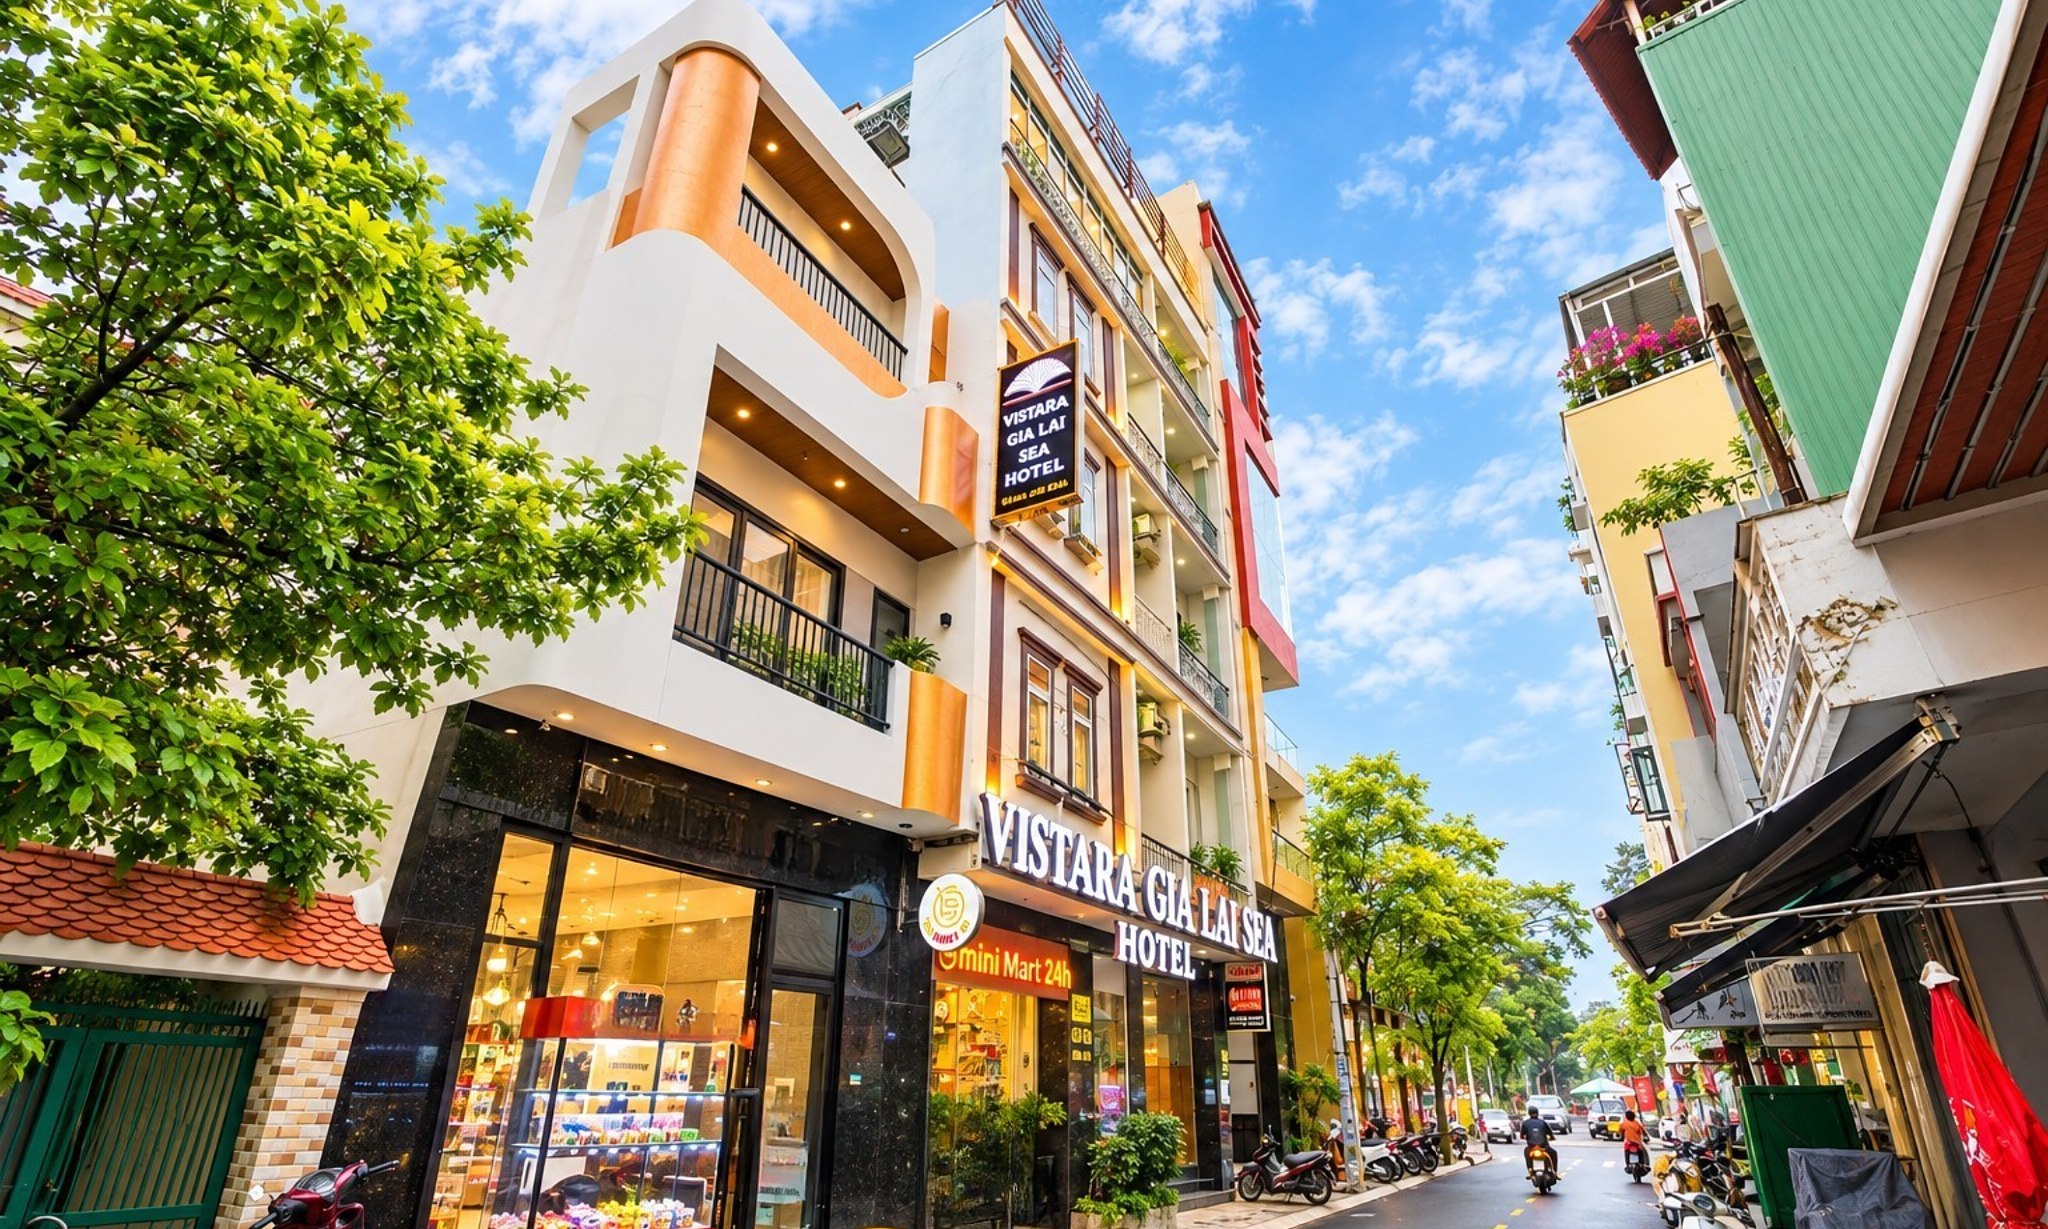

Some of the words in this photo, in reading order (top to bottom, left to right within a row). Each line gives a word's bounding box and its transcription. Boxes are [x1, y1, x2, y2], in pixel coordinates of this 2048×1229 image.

[1003, 395, 1069, 427] VISTARA
[1006, 429, 1036, 446] GIA
[1038, 415, 1067, 436] LAI
[1018, 443, 1050, 463] SEA
[1004, 458, 1065, 487] HOTEL
[980, 793, 1139, 916] VISTARA
[1143, 866, 1196, 934] GIA
[1199, 888, 1239, 948] LAI
[1240, 906, 1278, 963] SEA
[958, 943, 1000, 976] mini
[1003, 951, 1042, 983] Mart
[1114, 920, 1196, 980] HOTEL
